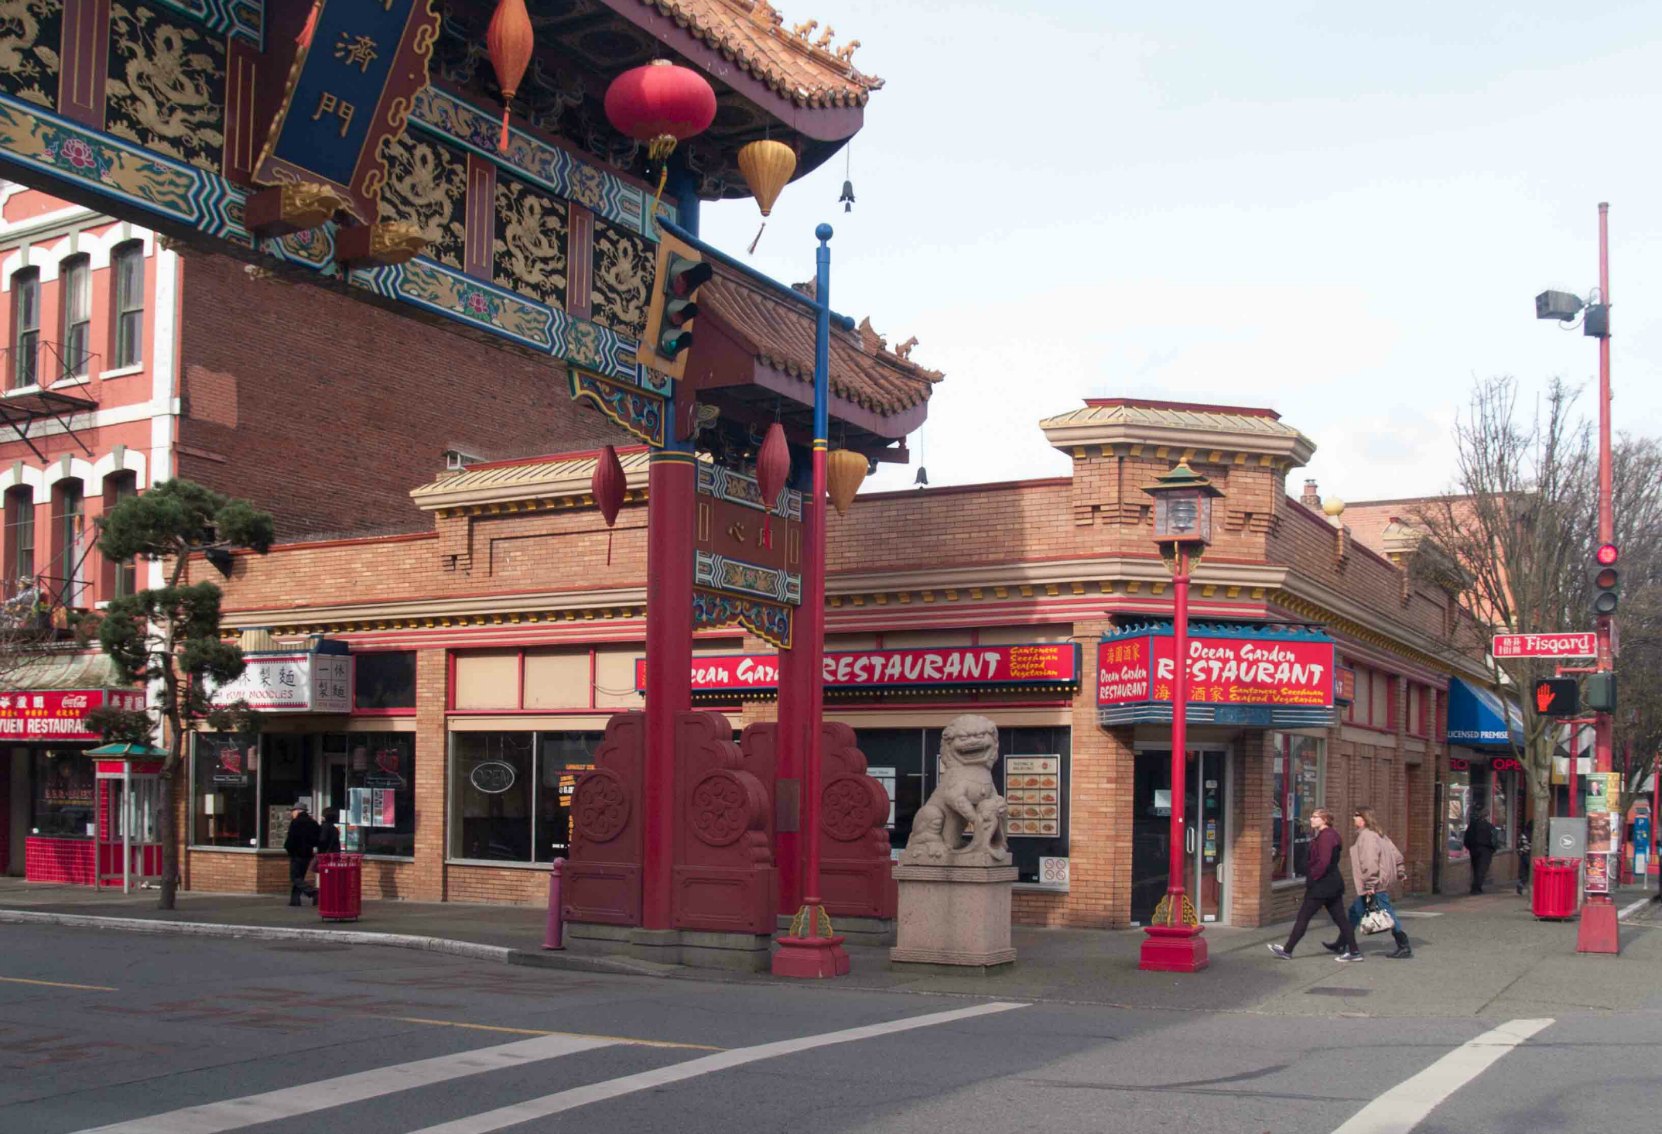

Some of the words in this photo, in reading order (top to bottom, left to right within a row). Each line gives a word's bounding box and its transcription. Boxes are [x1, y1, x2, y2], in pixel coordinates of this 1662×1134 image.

[312, 0, 392, 137] 濟門
[1010, 646, 1058, 654] Cantonese
[1525, 635, 1590, 653] Fisgard
[1190, 641, 1234, 659] Ocean
[1240, 643, 1295, 662] Garden
[691, 666, 728, 684] cean
[736, 658, 780, 684] Gar
[823, 652, 1001, 682] RESTAURANT
[1010, 661, 1045, 670] Seafood
[1010, 669, 1058, 678] Vegetarian
[1100, 668, 1119, 683] Ocean
[1121, 664, 1147, 681] Garden
[249, 690, 294, 699] NOODLES
[1100, 682, 1147, 699] RESTAURANT
[1154, 684, 1224, 702] 海酒家
[1229, 685, 1277, 694] Cantonese
[1229, 693, 1271, 703] Seafood
[1272, 694, 1324, 704] Vegetarian
[27, 719, 94, 733] RESTAURA
[1448, 730, 1479, 738] LICENSED
[1480, 731, 1509, 739] PREMISE
[1492, 758, 1521, 770] OPE
